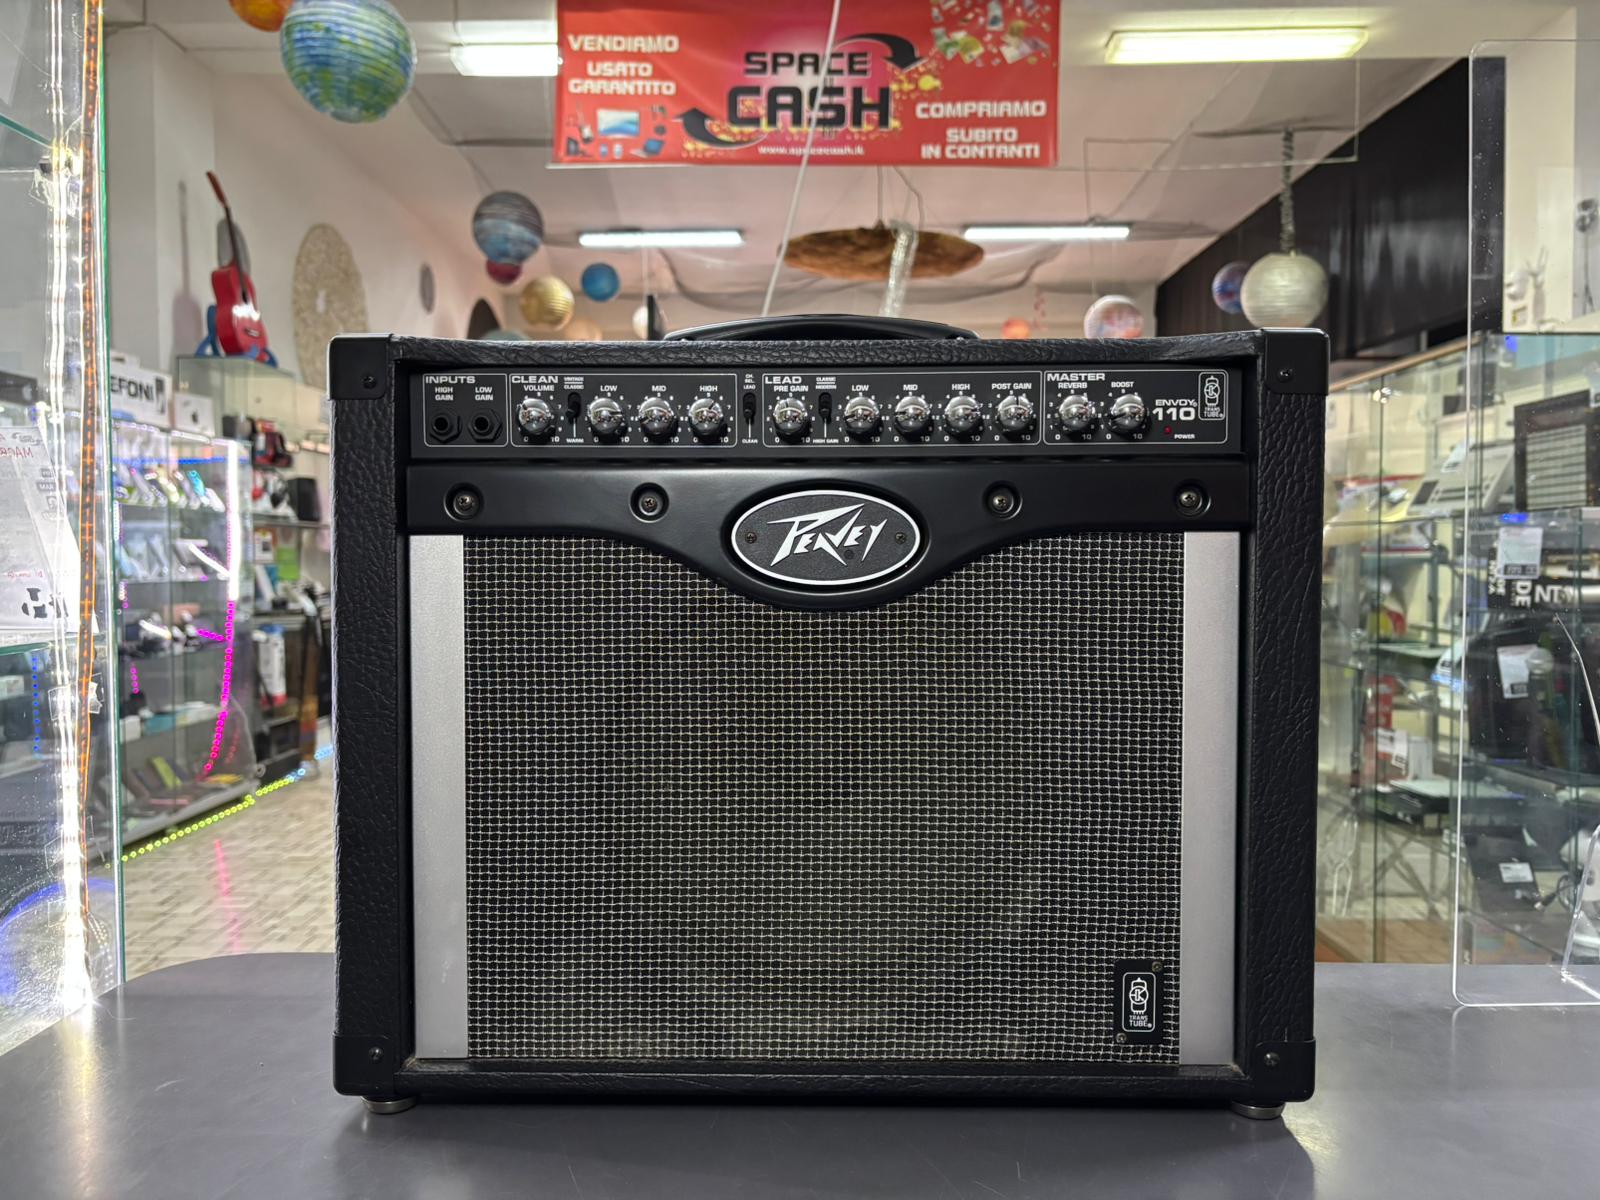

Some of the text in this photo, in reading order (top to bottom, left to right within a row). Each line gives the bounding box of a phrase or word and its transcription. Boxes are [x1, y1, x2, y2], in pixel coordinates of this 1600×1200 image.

[567, 34, 680, 53] VENDIAMO
[586, 60, 653, 77] USATO
[744, 51, 868, 76] SPACE
[567, 78, 677, 96] GARANTITO
[728, 86, 891, 128] CASH
[915, 100, 1048, 119] COMPRIAMO
[945, 127, 1018, 143] SUBITO
[921, 143, 1040, 159] IN CONTANTI
[425, 375, 476, 384] INPUTS
[511, 375, 559, 384] CLEAN
[764, 376, 802, 384] LEAD
[1046, 373, 1106, 381] MASTER
[1152, 407, 1196, 421] 110
[766, 502, 888, 567] PEAVEY
